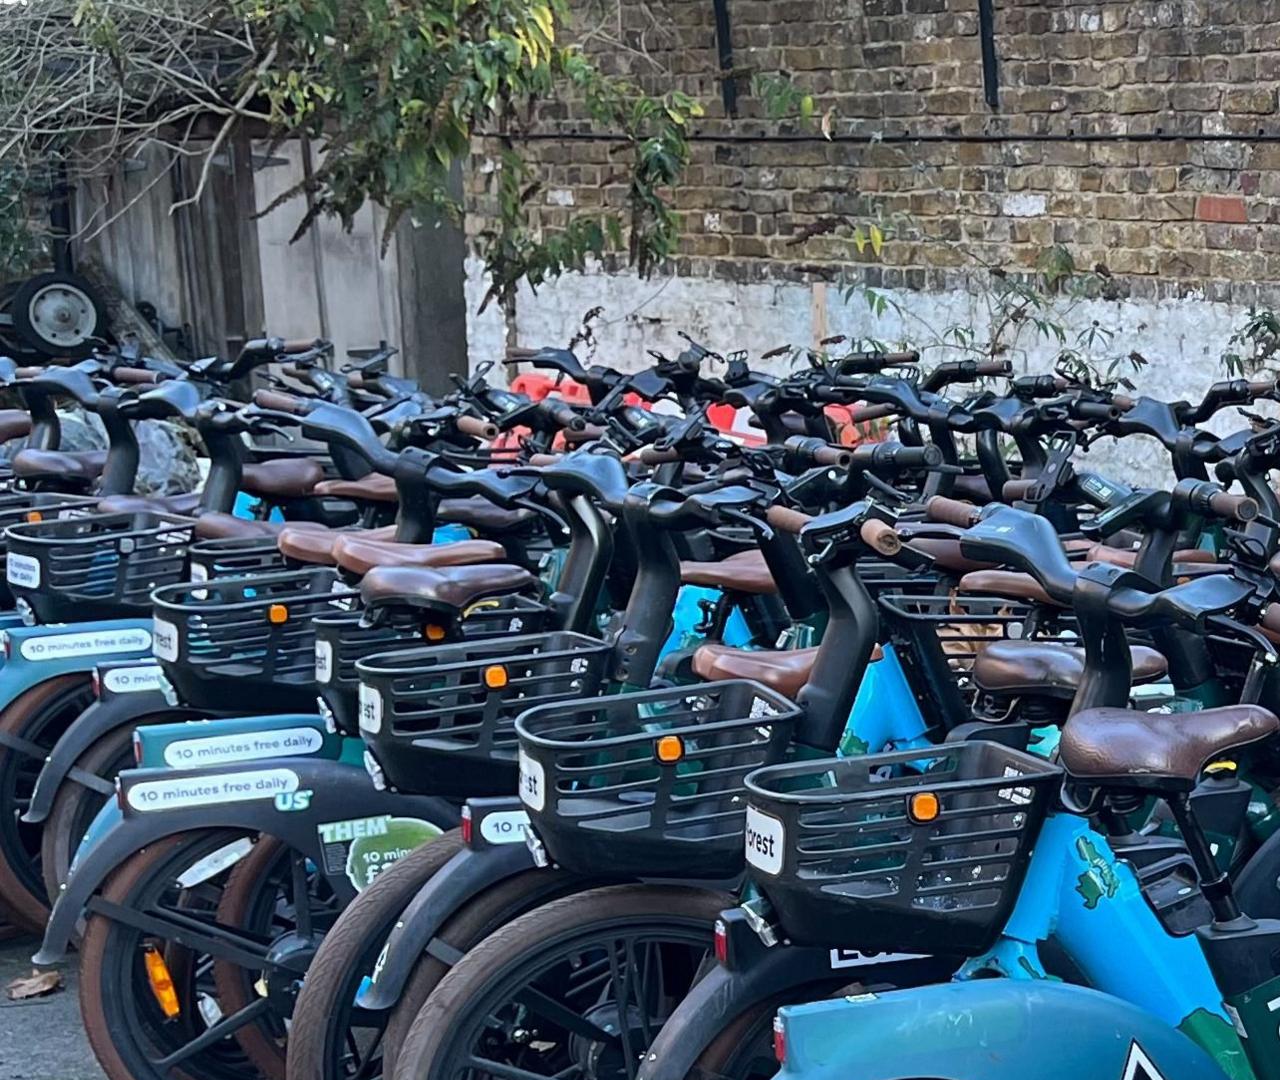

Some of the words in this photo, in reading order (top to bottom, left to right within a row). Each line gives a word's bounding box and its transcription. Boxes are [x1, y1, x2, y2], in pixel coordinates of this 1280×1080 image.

[29, 644, 45, 654] 10
[48, 640, 92, 653] minutes
[95, 637, 117, 647] free
[119, 634, 145, 648] daily
[114, 676, 130, 685] 10
[176, 748, 194, 760] 10
[198, 741, 251, 758] minutes
[253, 740, 280, 751] free
[283, 735, 313, 749] daily
[140, 790, 158, 802] 10
[162, 783, 219, 801] minutes
[222, 782, 251, 793] free
[255, 776, 289, 790] daily
[492, 821, 511, 833] 10
[362, 851, 380, 863] 10
